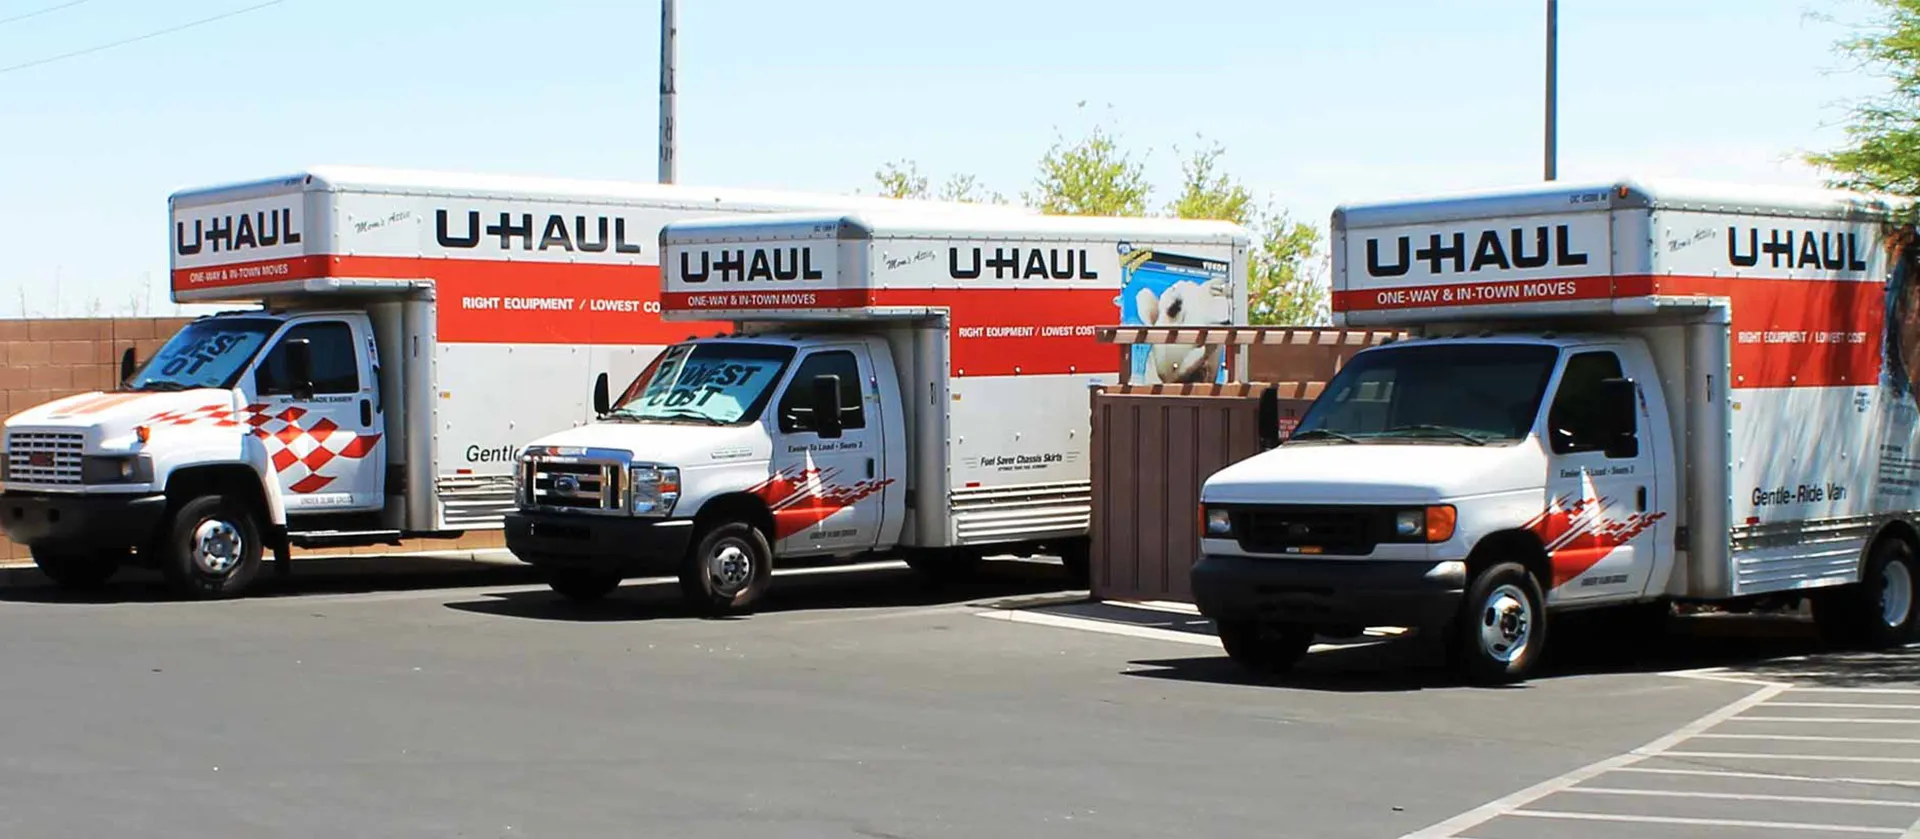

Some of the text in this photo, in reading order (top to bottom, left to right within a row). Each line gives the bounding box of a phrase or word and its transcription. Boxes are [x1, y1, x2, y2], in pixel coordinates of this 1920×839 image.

[177, 208, 301, 255] U-HAUL
[436, 209, 640, 254] U-HAUL
[1366, 224, 1588, 278] U-HAUL
[1728, 226, 1866, 271] U-HAUL
[190, 270, 222, 283] ONE-WAY
[229, 267, 261, 280] IN-TOWN
[262, 264, 288, 277] MOVES
[681, 247, 822, 283] U-HAUL
[950, 247, 1098, 280] U-HAUL
[688, 293, 816, 307] ONE-WAY & IN-TOWN MOVES
[1377, 281, 1577, 305] ONE-WAY & IN-TOWN MOVES
[462, 297, 500, 309] RIGHT
[504, 297, 574, 311] EQUIPMENT
[590, 300, 639, 313] LOWEST
[959, 327, 984, 337] RIGHT
[986, 326, 1034, 337] EQUIPMENT
[1042, 326, 1075, 336] LOWEST
[1076, 325, 1096, 336] COST
[1738, 331, 1762, 343] RIGHT
[1764, 331, 1808, 343] EQUIPMENT
[981, 453, 1063, 467] Fuel Saver Chassis Skirts
[1826, 482, 1847, 501] Van
